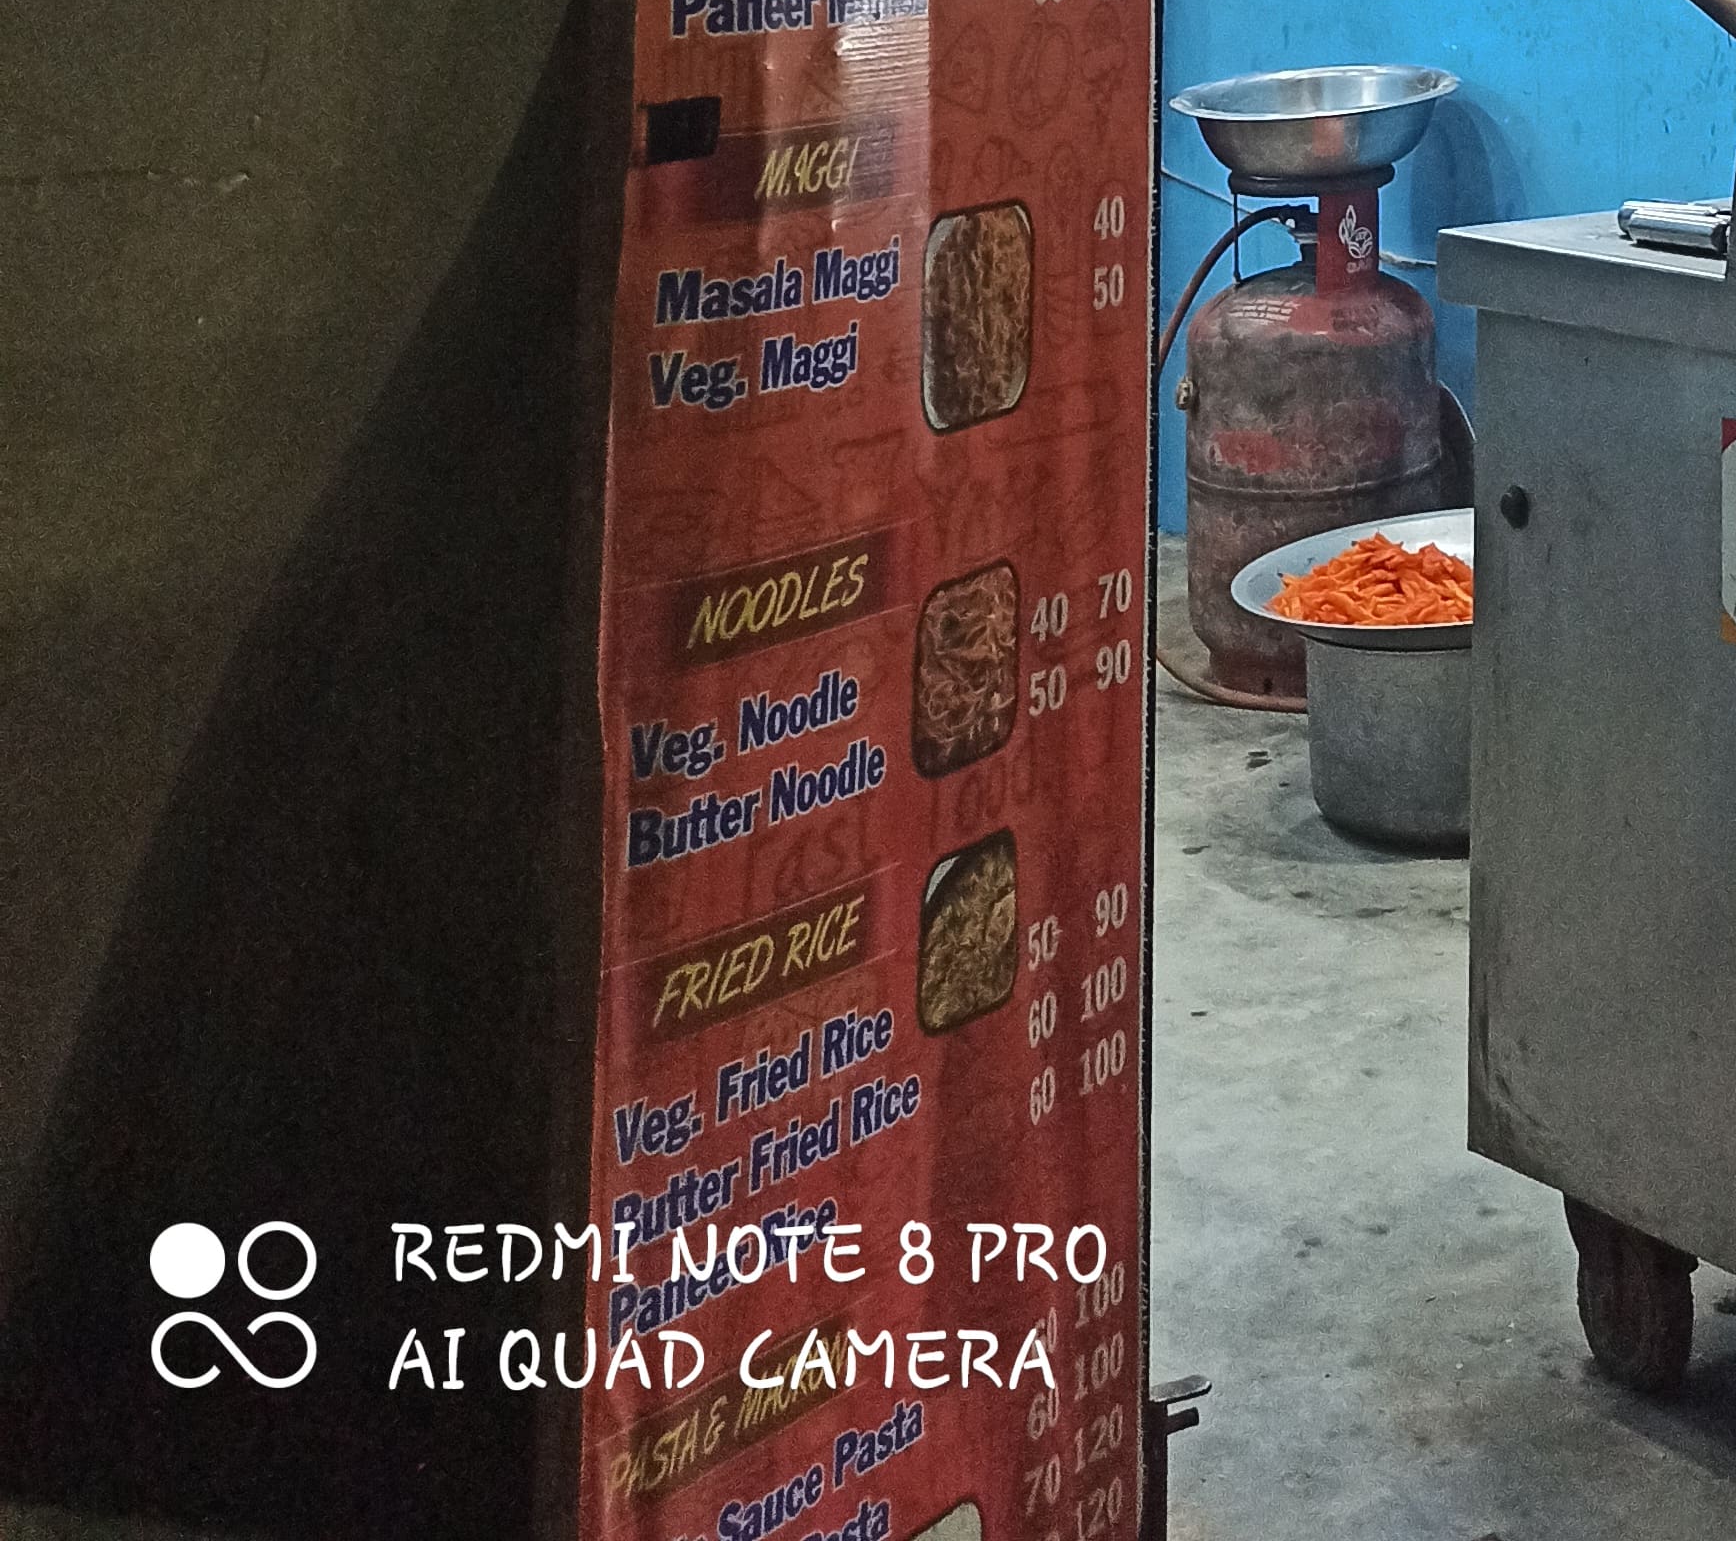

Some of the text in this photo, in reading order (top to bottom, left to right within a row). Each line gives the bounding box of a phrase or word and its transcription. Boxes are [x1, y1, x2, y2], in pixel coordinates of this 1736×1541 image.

[654, 234, 901, 327] Masala Maggi
[1093, 263, 1126, 311] 50
[649, 320, 860, 412] Veg. Maggi
[686, 553, 871, 651] NOODLES
[1029, 568, 1134, 644] 40 70
[1028, 639, 1132, 718] 50 90
[629, 670, 860, 785] Veg. Noodle
[626, 739, 887, 870] Butter Noodle
[652, 894, 866, 1030] FRIED RICE
[614, 1007, 895, 1166] Veg. Fried Rice
[611, 1071, 922, 1261] Butter Fried Rice
[833, 1397, 925, 1494] Pasta
